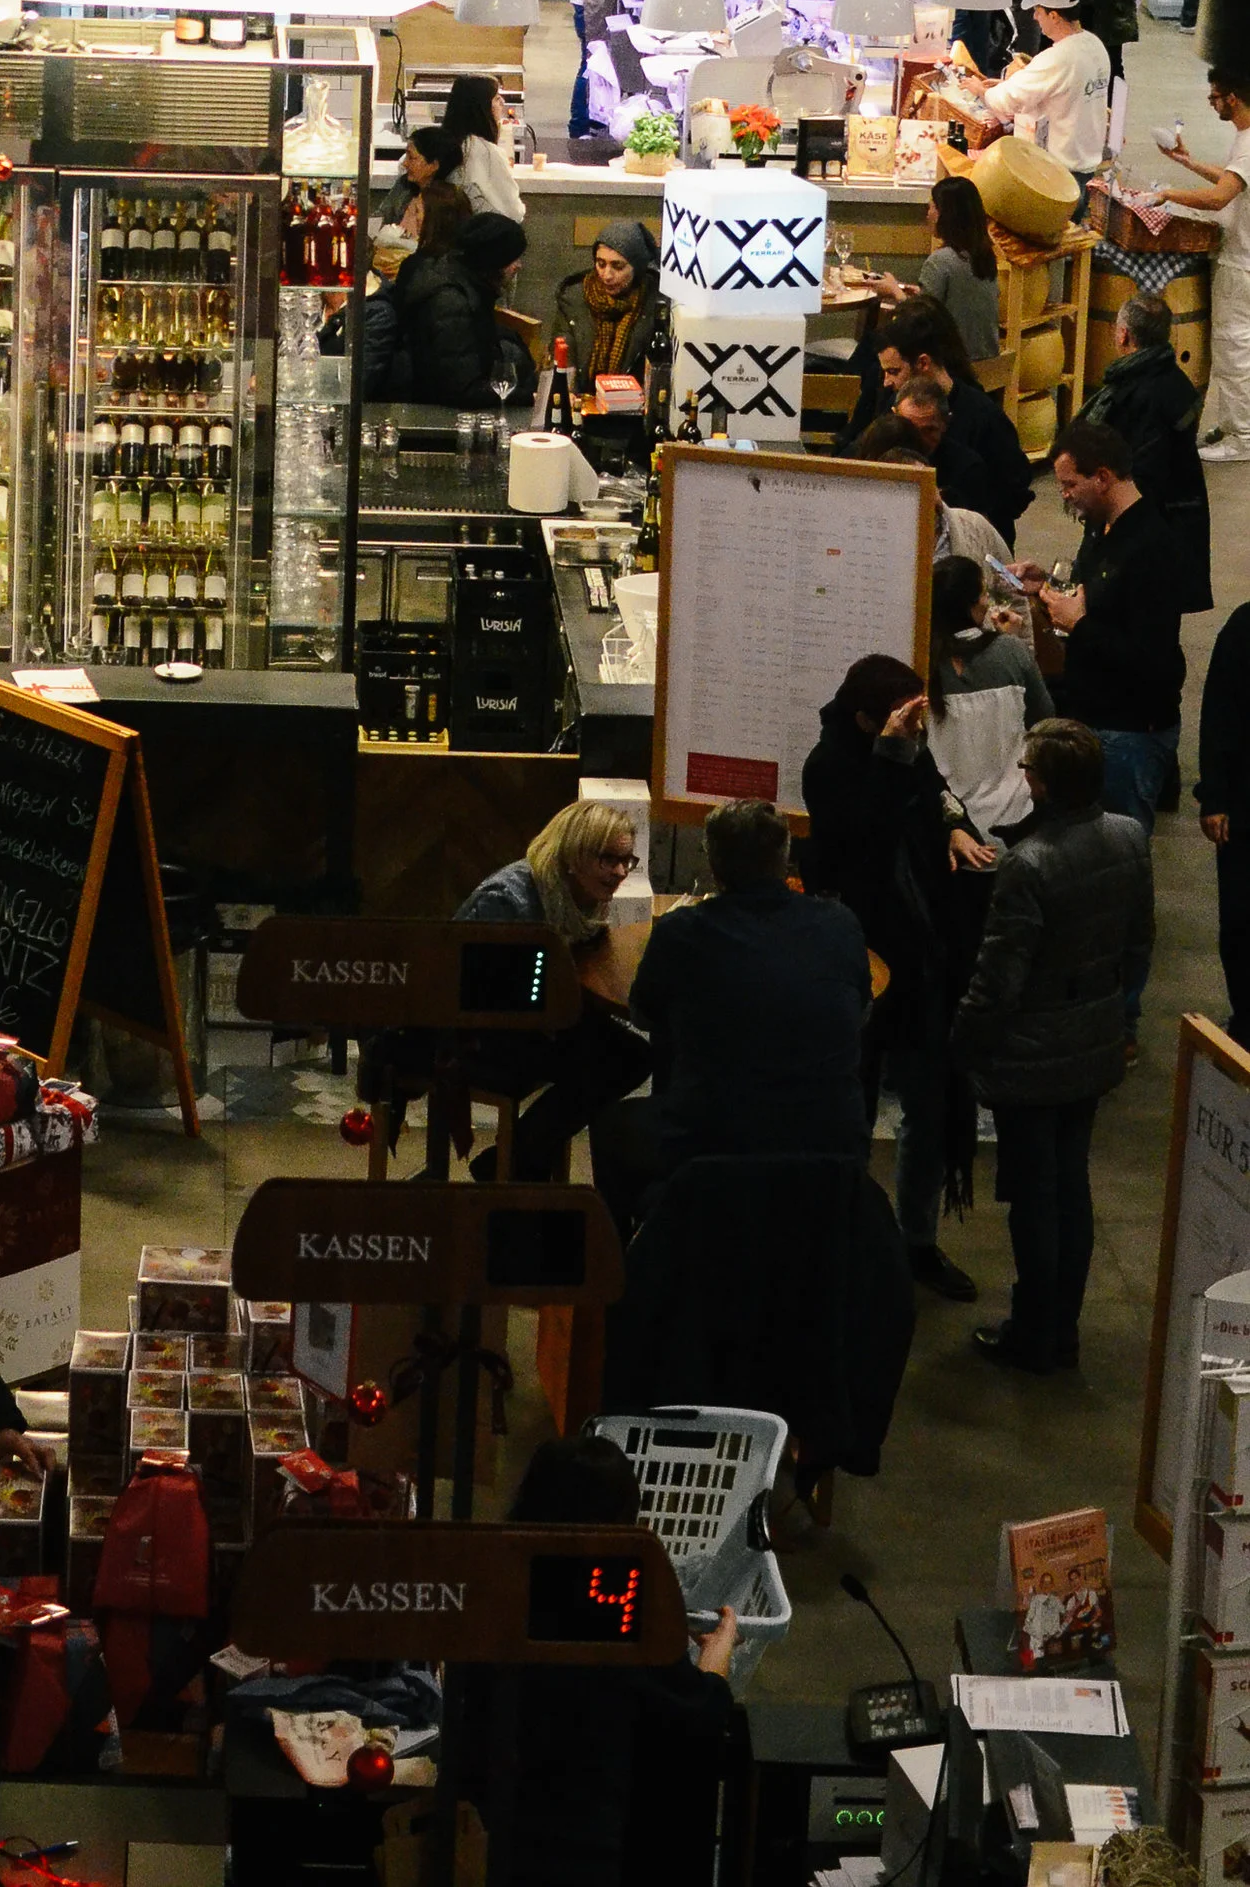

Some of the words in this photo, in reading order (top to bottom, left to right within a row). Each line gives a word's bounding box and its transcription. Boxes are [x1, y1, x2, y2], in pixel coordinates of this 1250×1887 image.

[480, 616, 523, 633] LURISIA
[476, 695, 519, 712] LURISIA
[290, 959, 409, 986] KASSEN
[298, 1232, 433, 1263] KASSEN
[310, 1581, 468, 1614] KASSEN
[588, 1565, 641, 1636] 4
